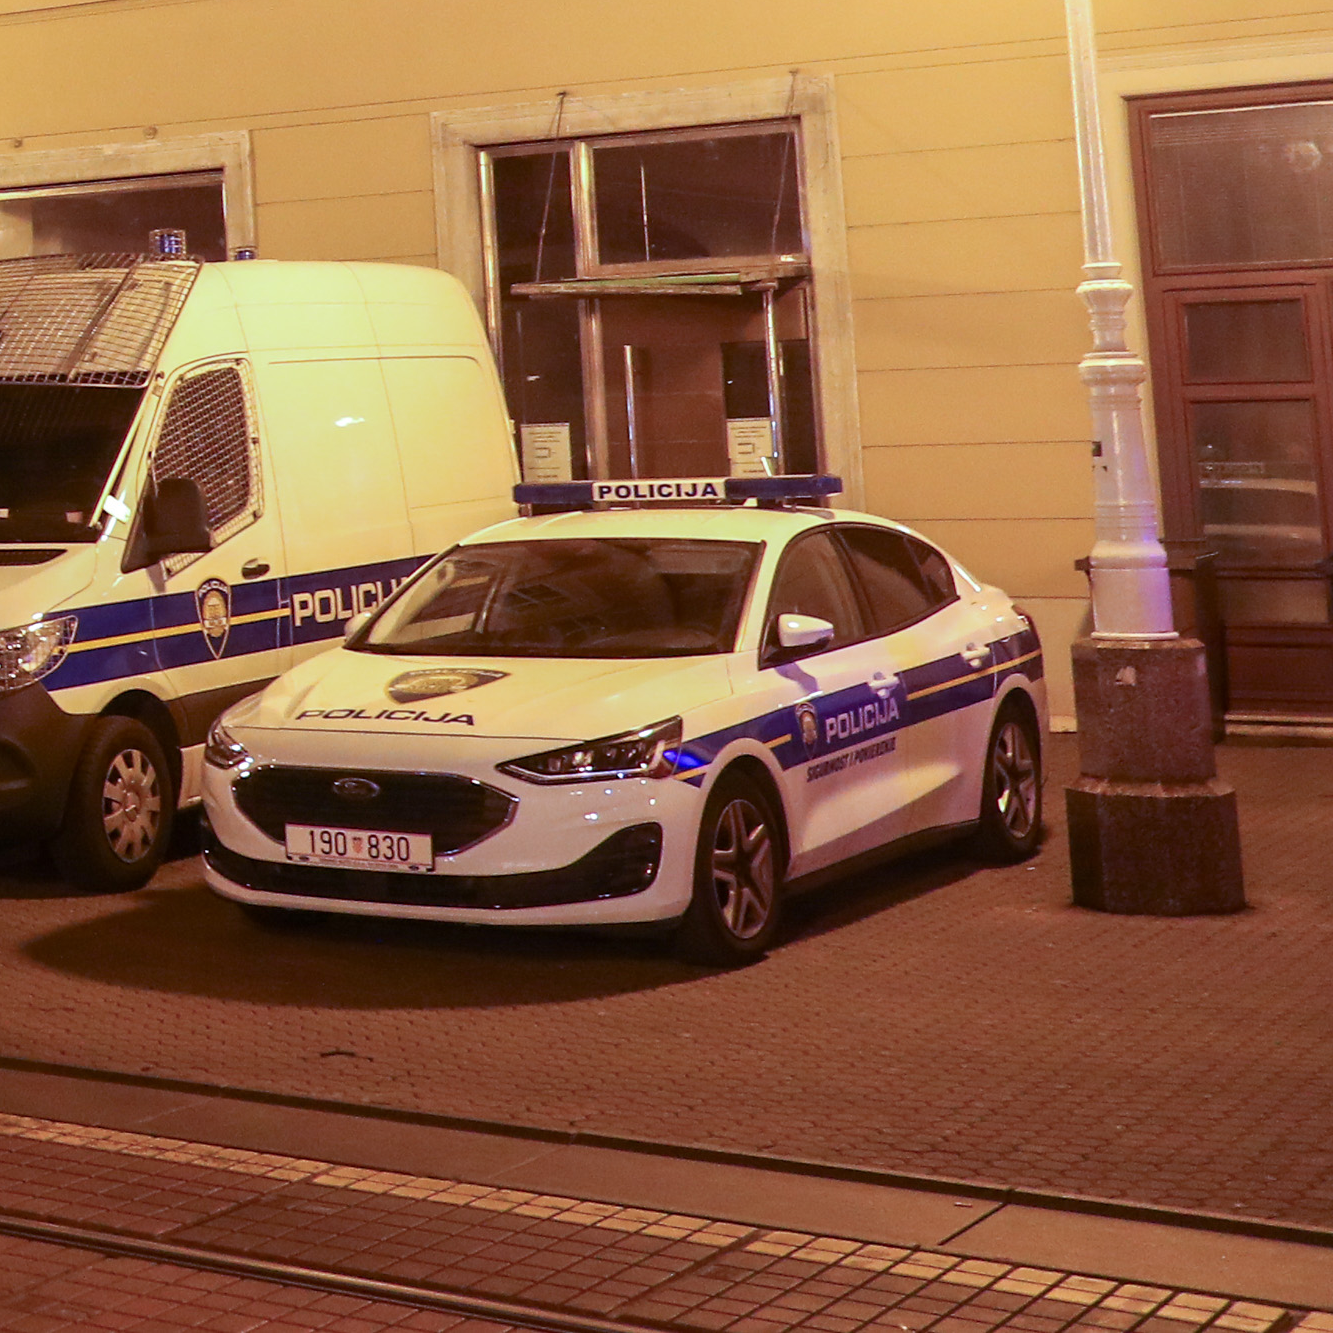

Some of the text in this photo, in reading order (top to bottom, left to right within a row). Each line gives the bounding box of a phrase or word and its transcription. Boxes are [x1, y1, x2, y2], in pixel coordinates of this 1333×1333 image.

[598, 483, 718, 499] POLICIJA
[295, 709, 475, 726] POLICIJA
[825, 698, 899, 744] POLICIJA
[309, 830, 410, 861] 190 830
